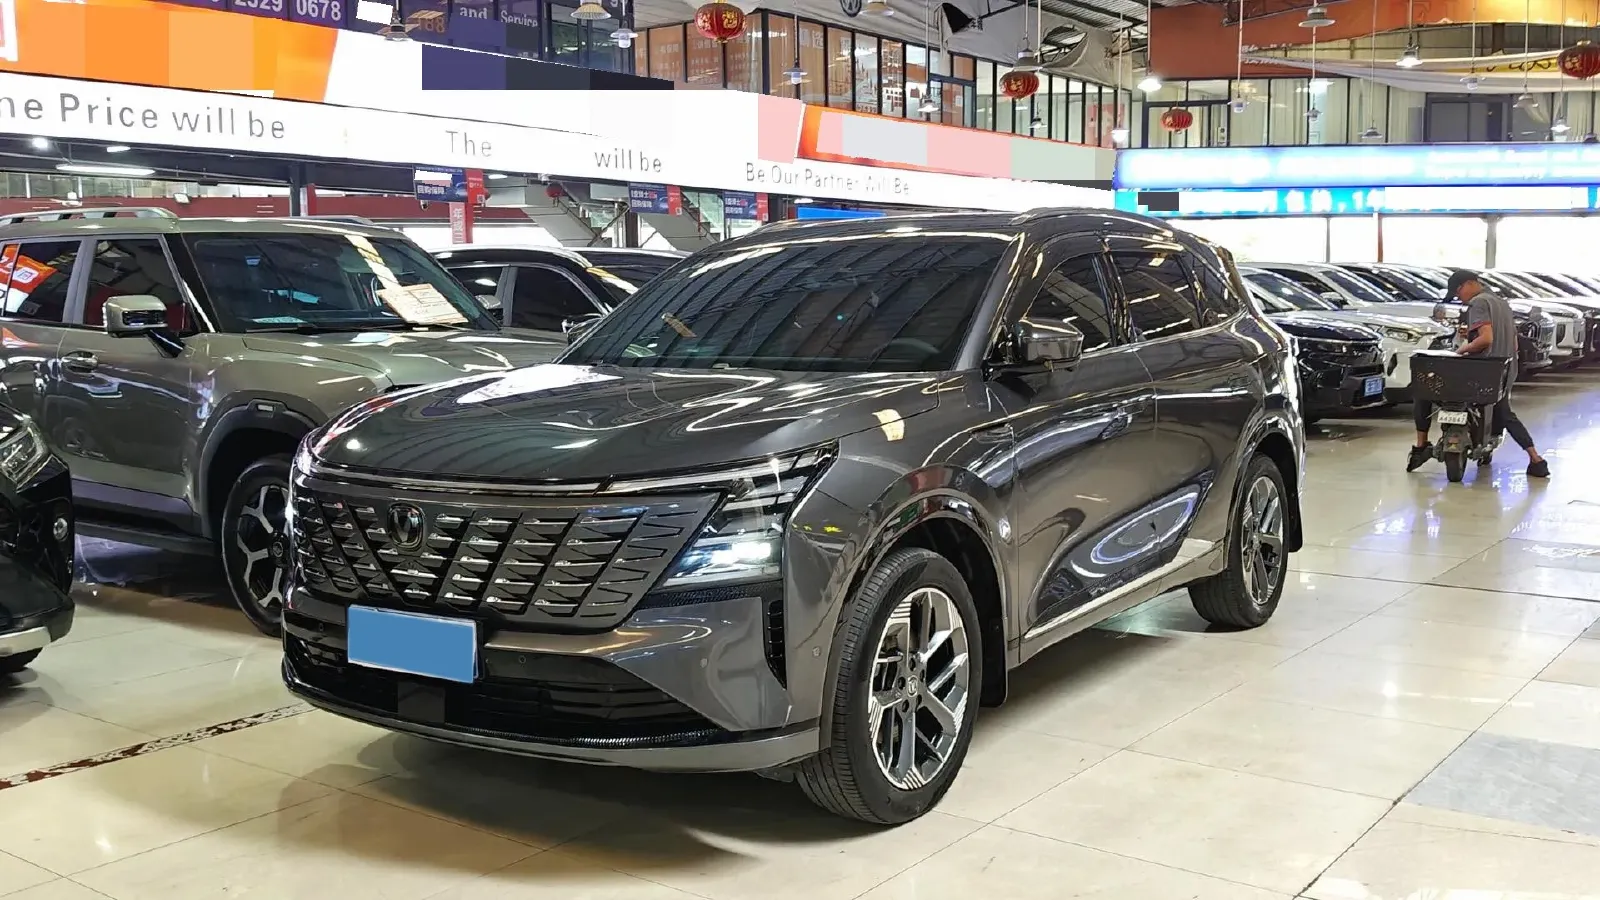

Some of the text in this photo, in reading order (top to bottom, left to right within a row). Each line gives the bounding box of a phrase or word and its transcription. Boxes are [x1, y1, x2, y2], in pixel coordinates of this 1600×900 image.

[235, 0, 342, 21] 29 0678
[459, 6, 488, 20] and
[59, 92, 159, 130] Price
[172, 106, 236, 136] will
[249, 110, 286, 139] be
[445, 130, 493, 157] The
[594, 147, 662, 173] will be
[746, 162, 765, 182] Be
[771, 165, 799, 184] Our
[805, 168, 859, 190] Partner
